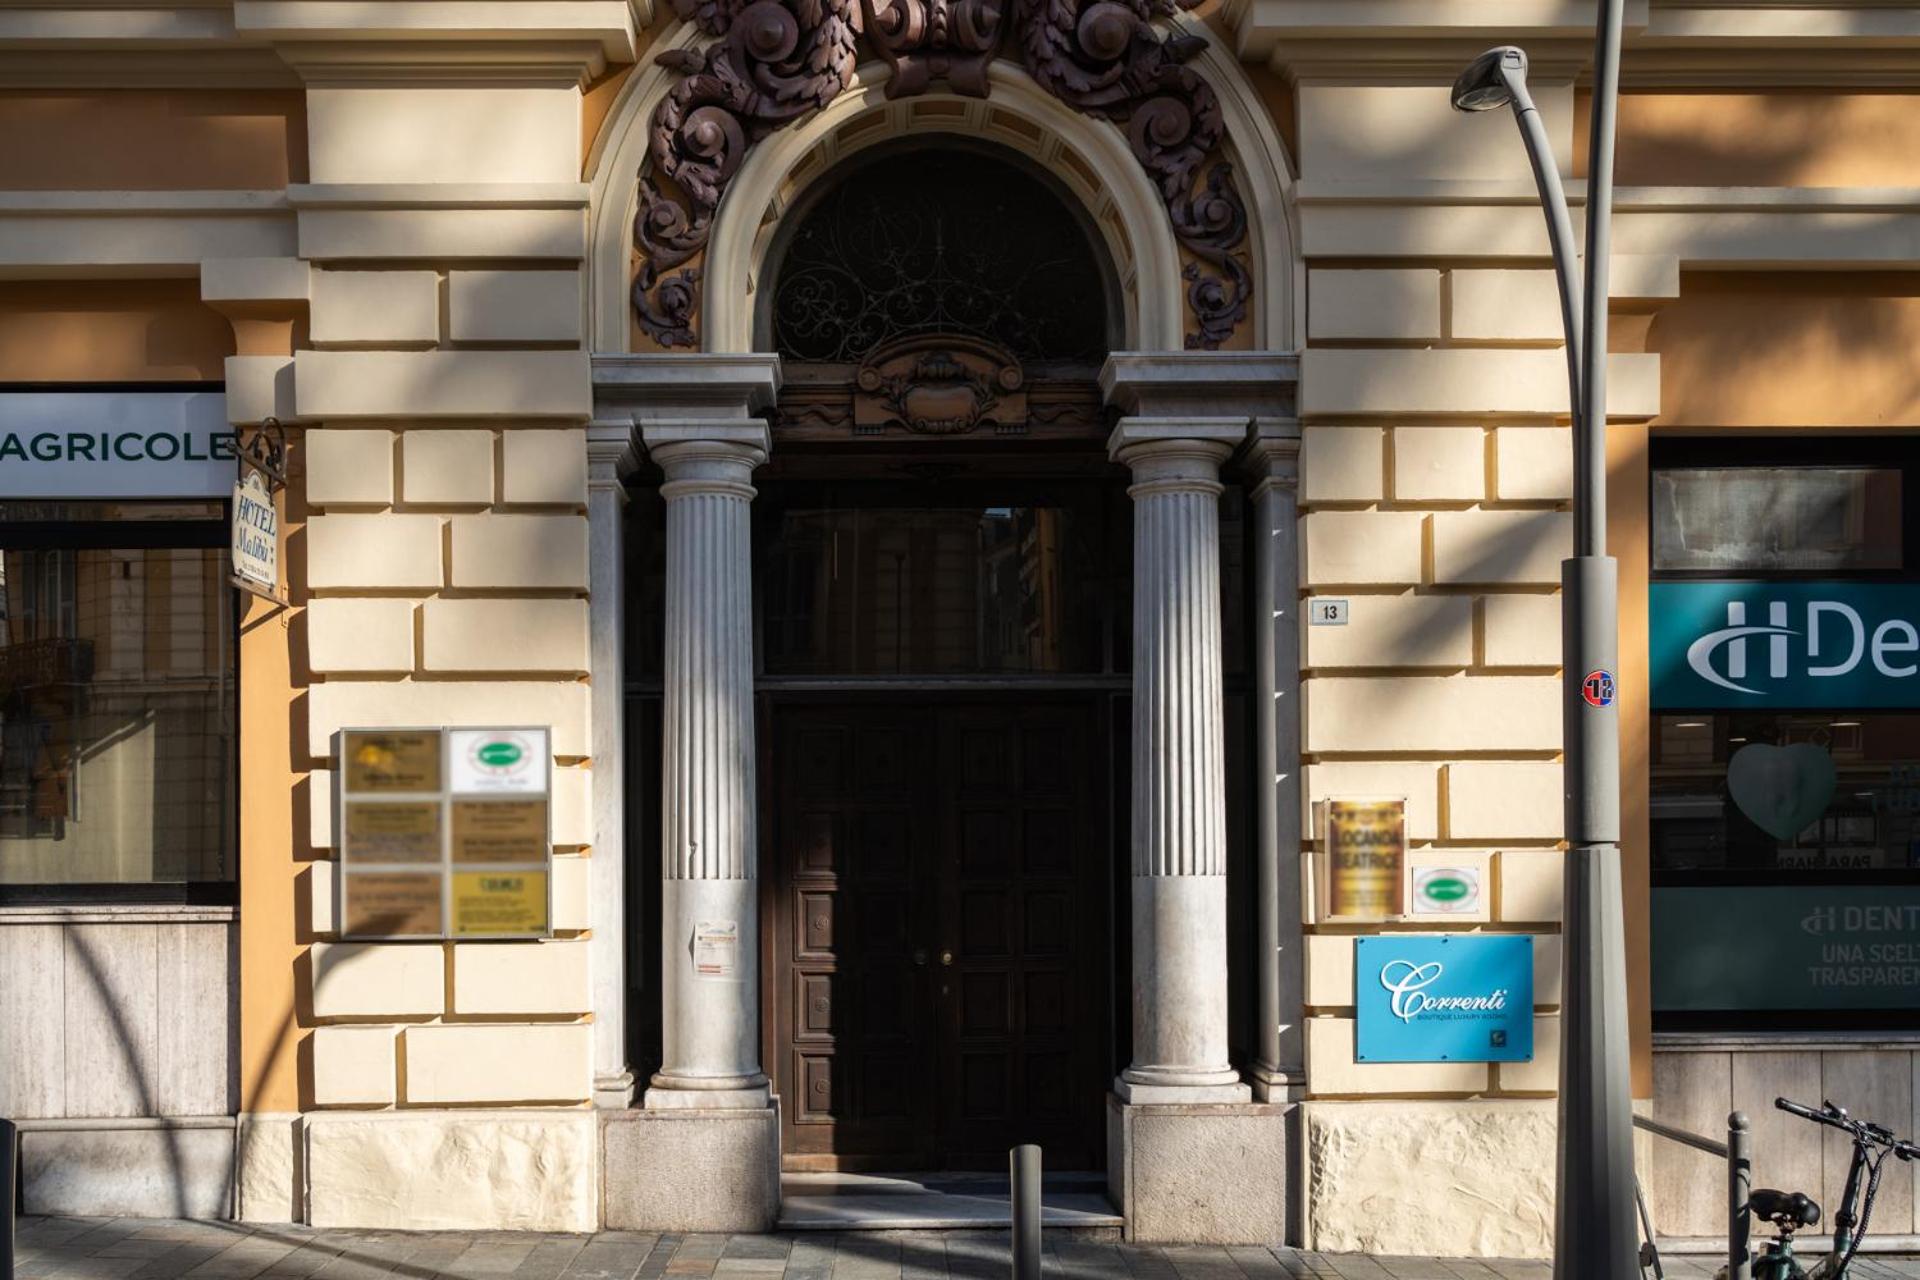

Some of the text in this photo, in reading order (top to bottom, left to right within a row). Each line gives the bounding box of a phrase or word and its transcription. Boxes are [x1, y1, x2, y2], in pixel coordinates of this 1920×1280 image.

[0, 432, 236, 462] AGRICOLE
[236, 495, 275, 537] HOTEL
[1323, 604, 1338, 620] 13
[1822, 943, 1920, 963] UNA SCEL
[1380, 960, 1507, 1024] Correnti
